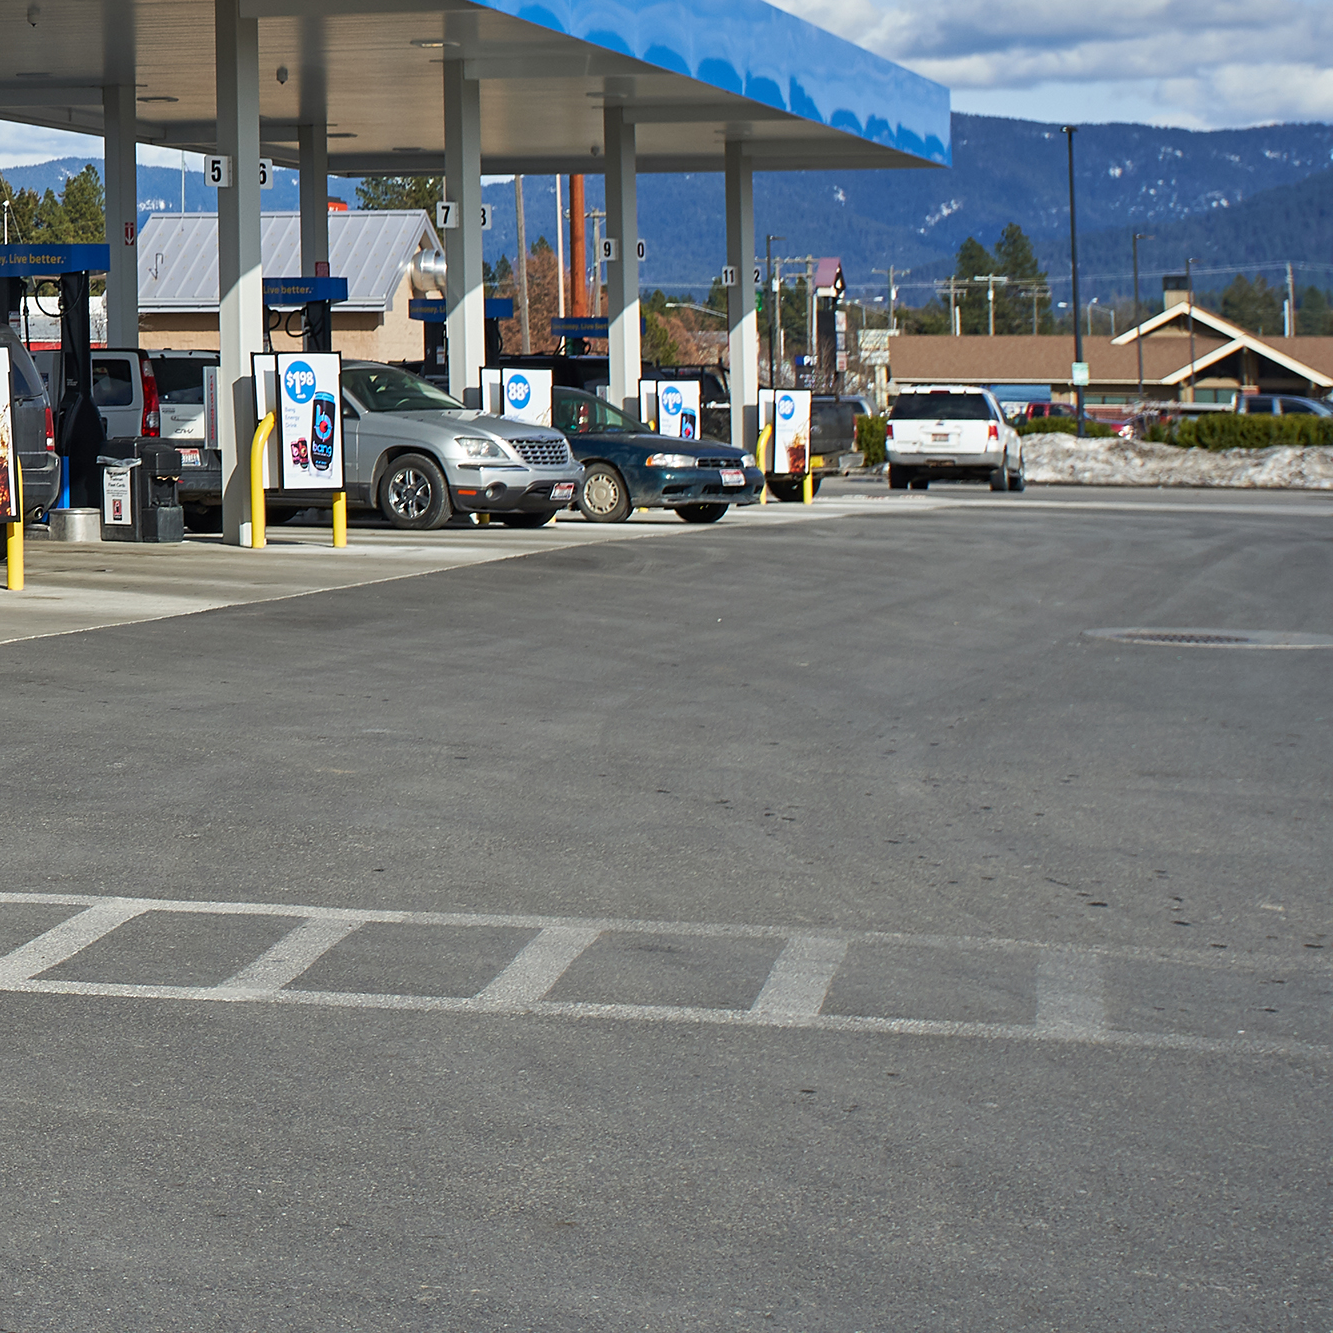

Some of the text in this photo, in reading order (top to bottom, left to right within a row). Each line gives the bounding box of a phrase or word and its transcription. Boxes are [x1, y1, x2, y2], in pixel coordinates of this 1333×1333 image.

[211, 159, 221, 182] 5
[441, 206, 450, 224] 7
[603, 241, 611, 257] 9
[637, 241, 645, 258] 0
[9, 254, 28, 264] Live
[29, 254, 65, 264] better.
[722, 269, 734, 283] 11
[263, 285, 312, 295] Live better.
[508, 382, 529, 401] 88¢
[312, 440, 332, 457] bang
